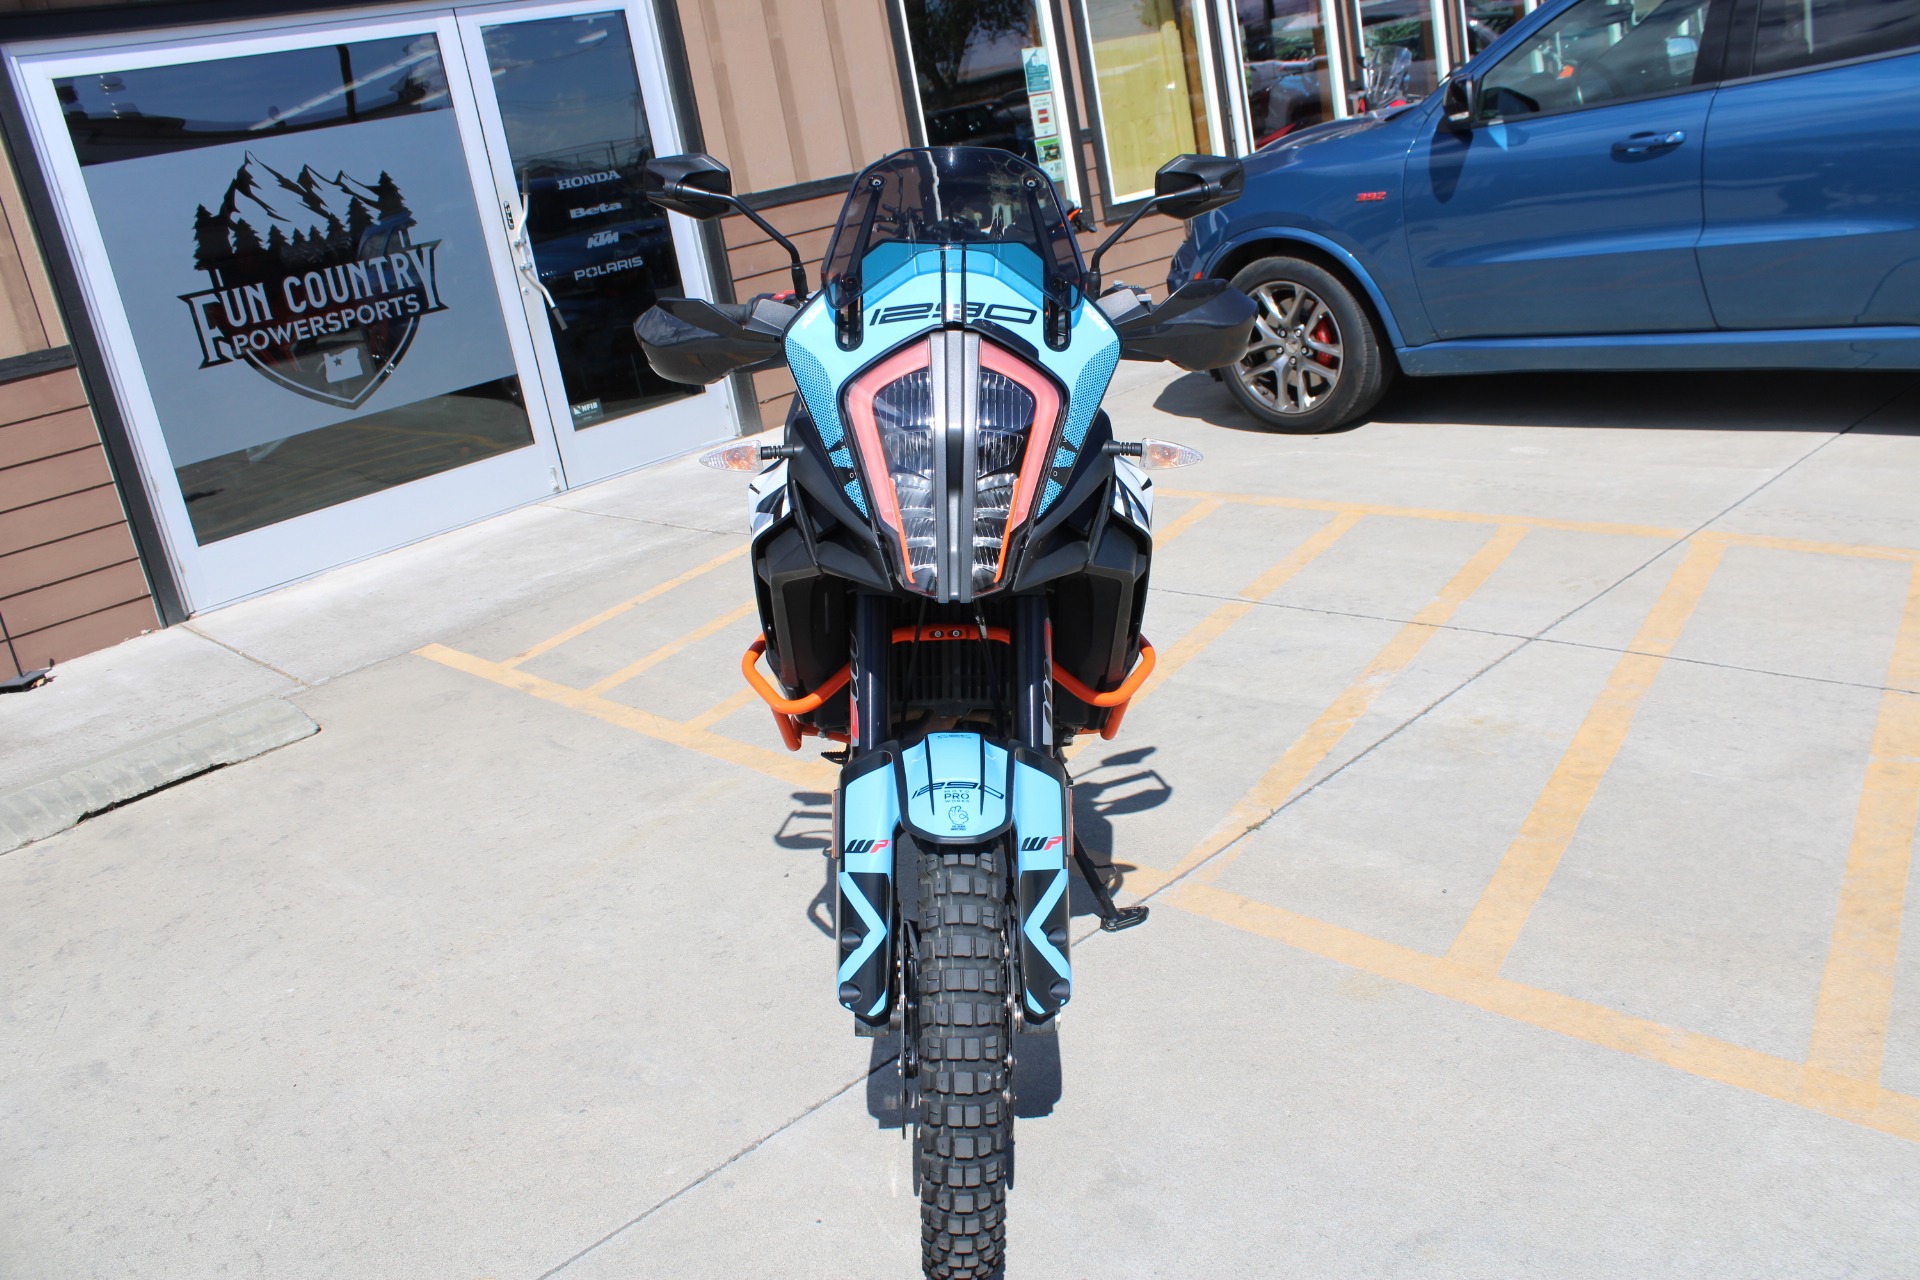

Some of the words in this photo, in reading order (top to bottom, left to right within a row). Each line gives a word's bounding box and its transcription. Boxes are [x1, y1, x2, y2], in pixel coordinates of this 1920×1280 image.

[557, 170, 621, 190] HONDA
[1356, 191, 1386, 202] 392
[570, 202, 622, 219] Beta
[587, 230, 619, 249] KTM
[574, 256, 644, 281] POLARIS
[190, 282, 274, 364] FUN
[283, 247, 439, 314] COUNTRY
[232, 294, 421, 355] POWERSPORTS
[845, 839, 889, 854] WP
[1021, 835, 1063, 852] WP
